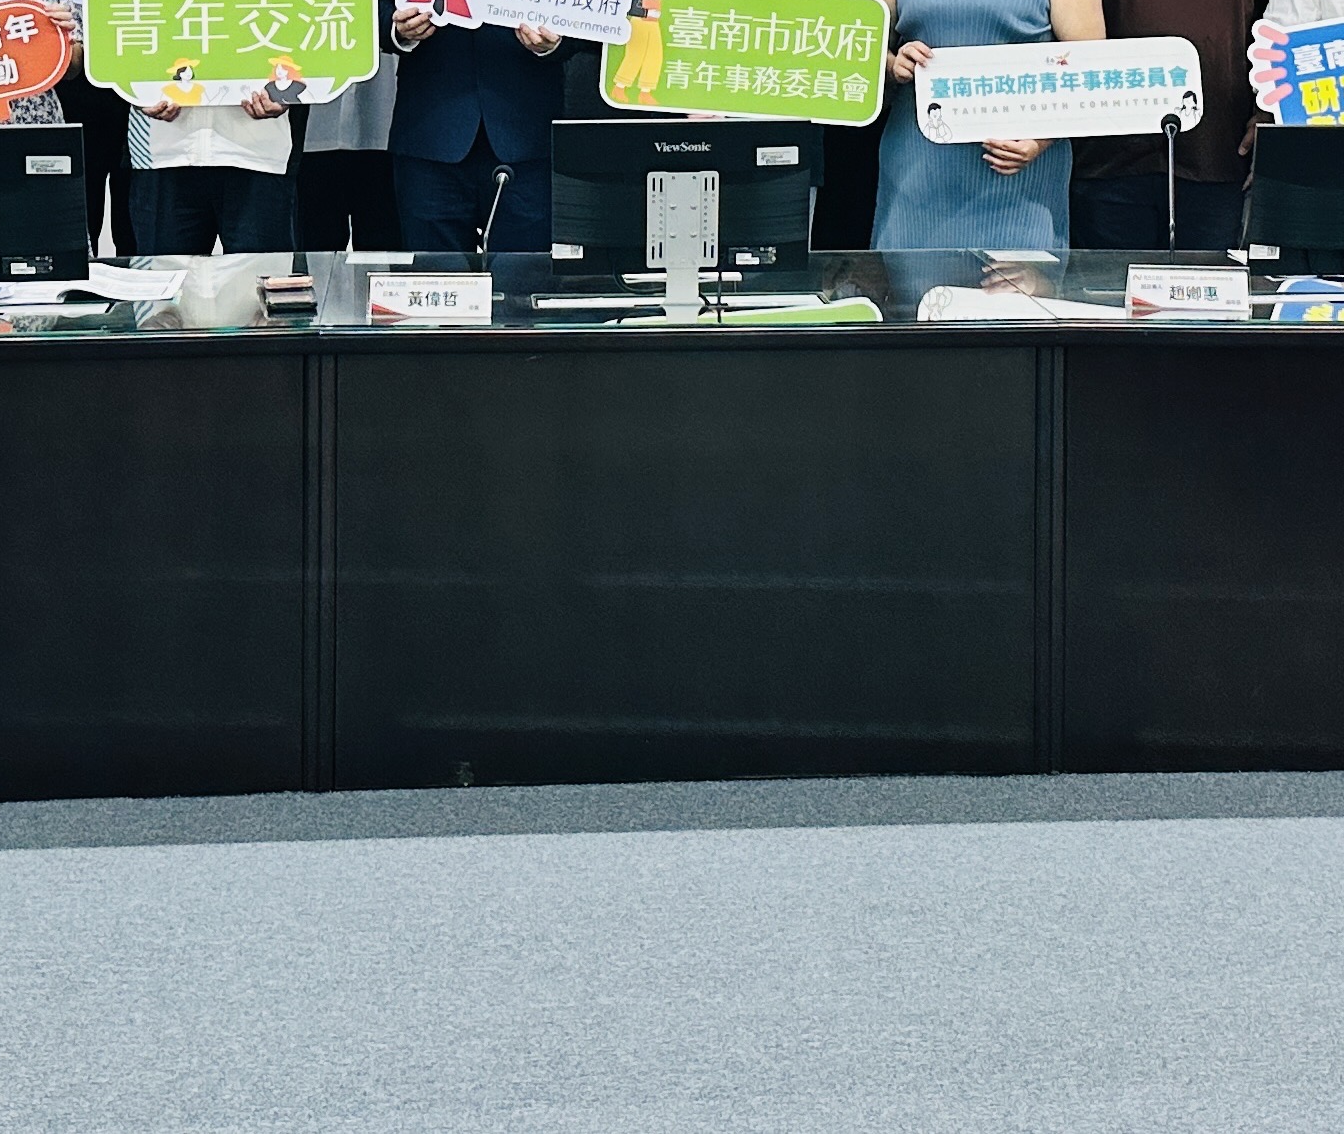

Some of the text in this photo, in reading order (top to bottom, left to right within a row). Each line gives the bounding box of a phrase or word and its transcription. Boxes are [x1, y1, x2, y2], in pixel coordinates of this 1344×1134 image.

[487, 3, 622, 37] Tainan City Government
[665, 6, 879, 62] 臺南市政府
[663, 59, 871, 104] 青年事務委員會
[929, 65, 1189, 100] 臺南市政府青年事務委員會
[953, 96, 1170, 116] TAINAN YOUTH COMMITTEE
[654, 141, 712, 153] ViewSonic
[407, 290, 459, 308] 黃偉哲
